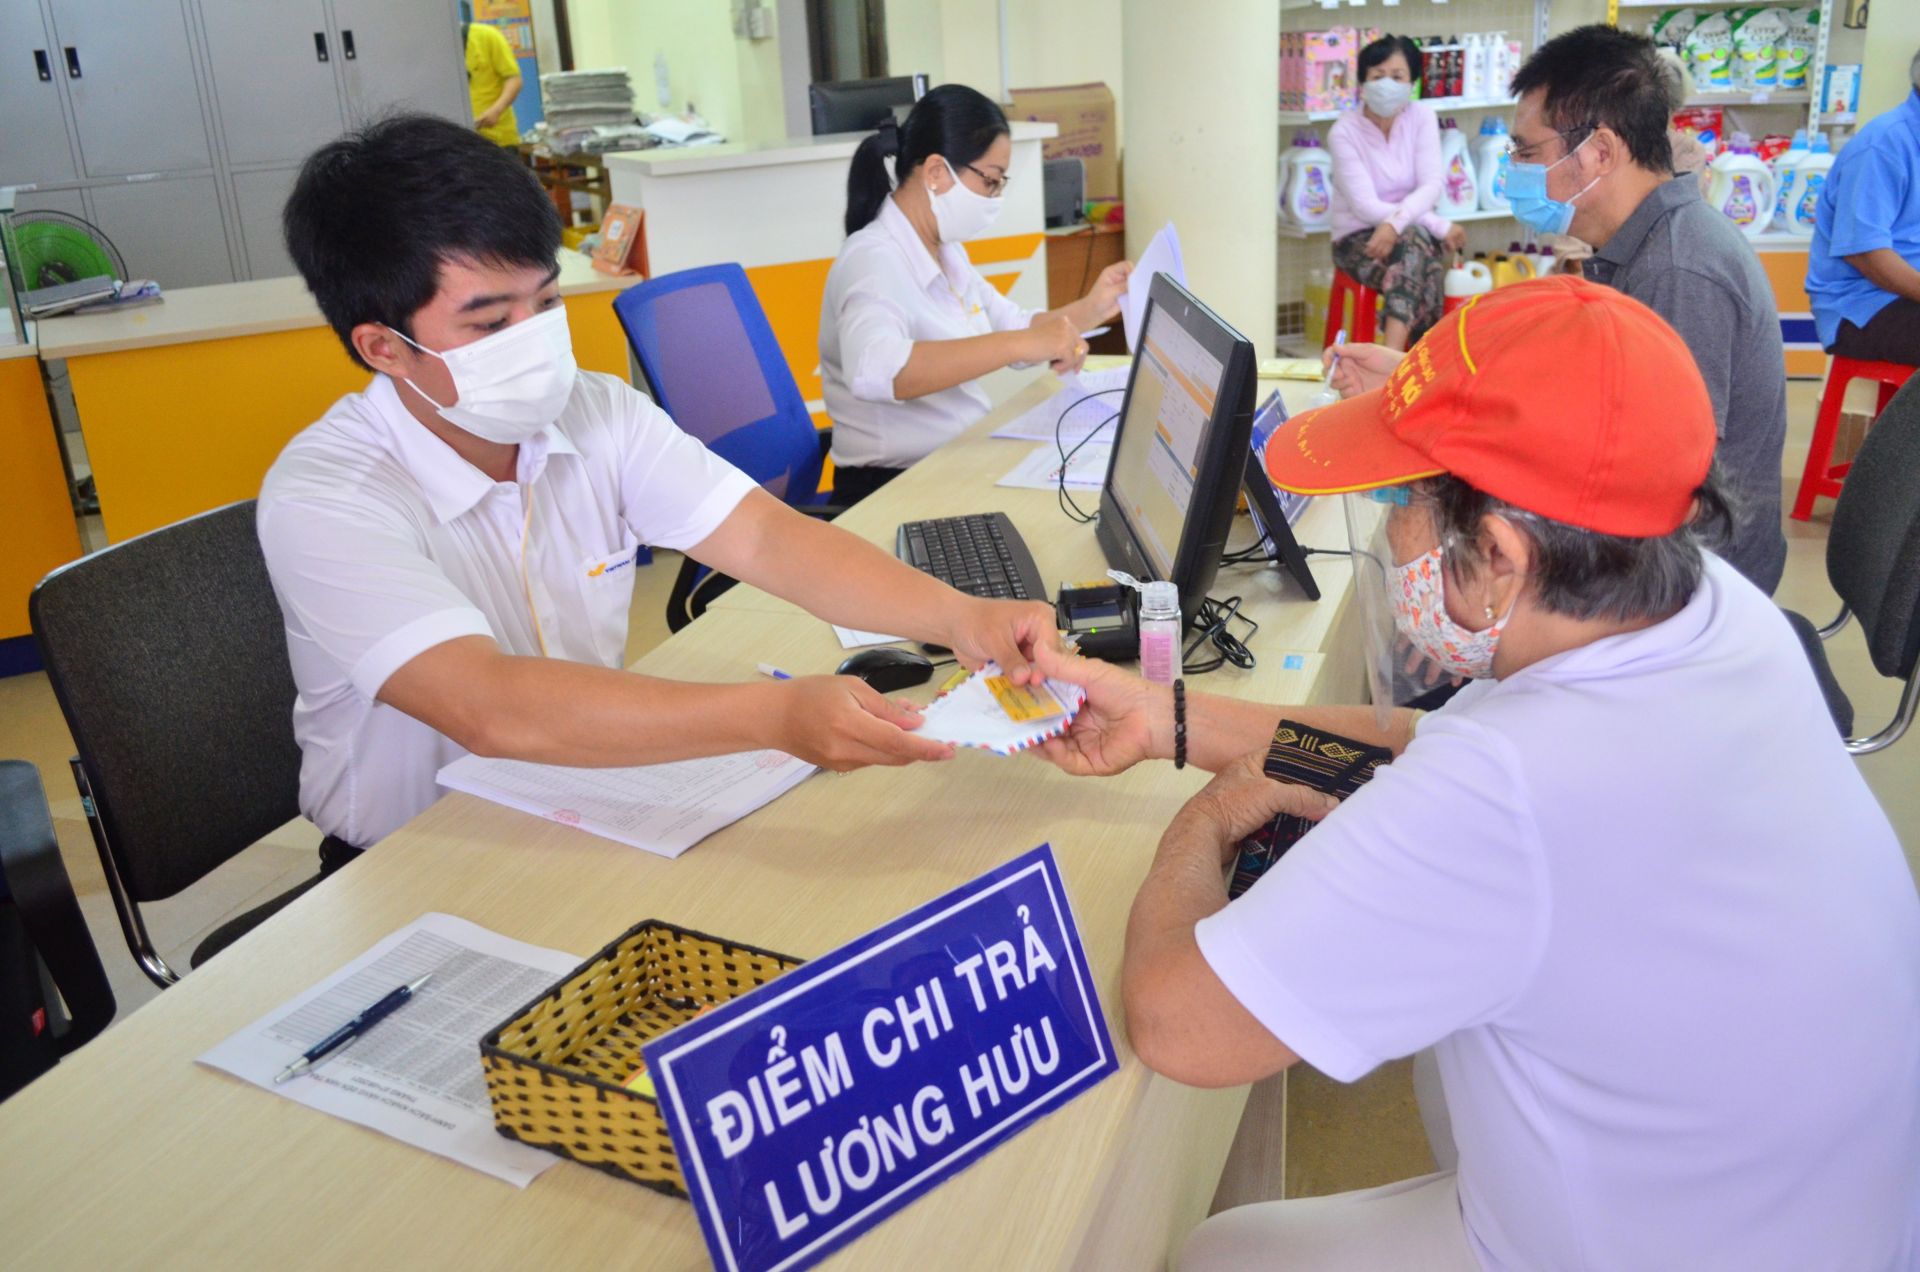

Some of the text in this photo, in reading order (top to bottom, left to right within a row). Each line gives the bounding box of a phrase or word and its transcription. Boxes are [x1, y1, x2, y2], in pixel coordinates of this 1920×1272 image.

[706, 904, 1056, 1159] ĐIỂM CHI TRẢ
[764, 1016, 1060, 1240] LƯƠNG HƯU
